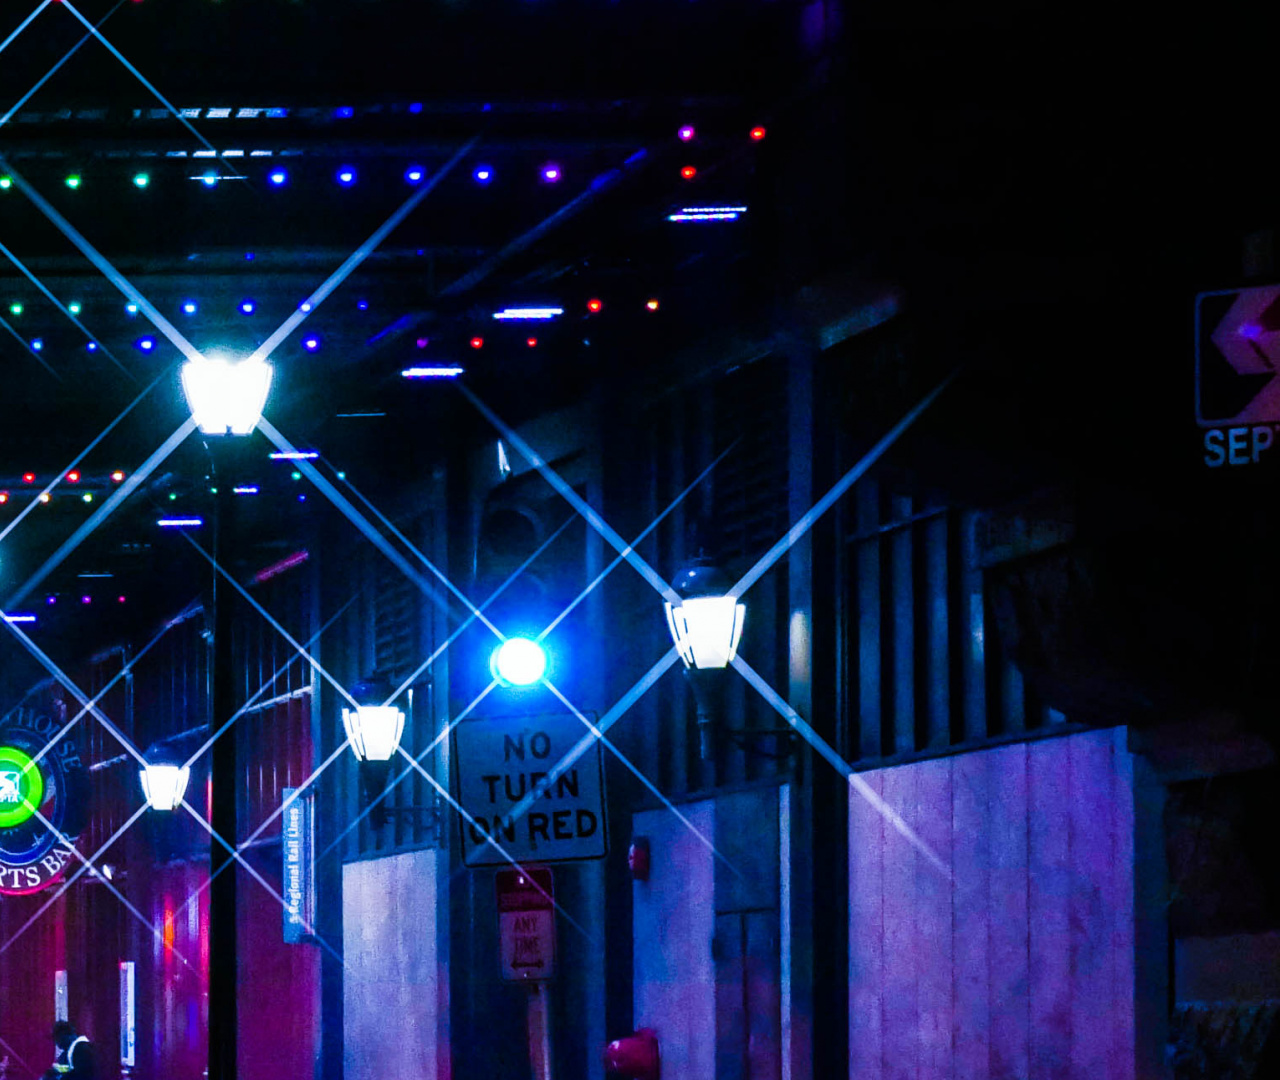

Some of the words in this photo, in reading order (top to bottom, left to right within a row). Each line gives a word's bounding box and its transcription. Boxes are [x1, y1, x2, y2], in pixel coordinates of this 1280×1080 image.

[1203, 424, 1280, 468] SEP
[503, 732, 551, 762] NO
[481, 769, 579, 804] TURN
[287, 808, 300, 837] Lines
[468, 815, 516, 846] ON
[528, 808, 598, 842] RED
[287, 840, 300, 862] Rail
[287, 865, 302, 913] Regional
